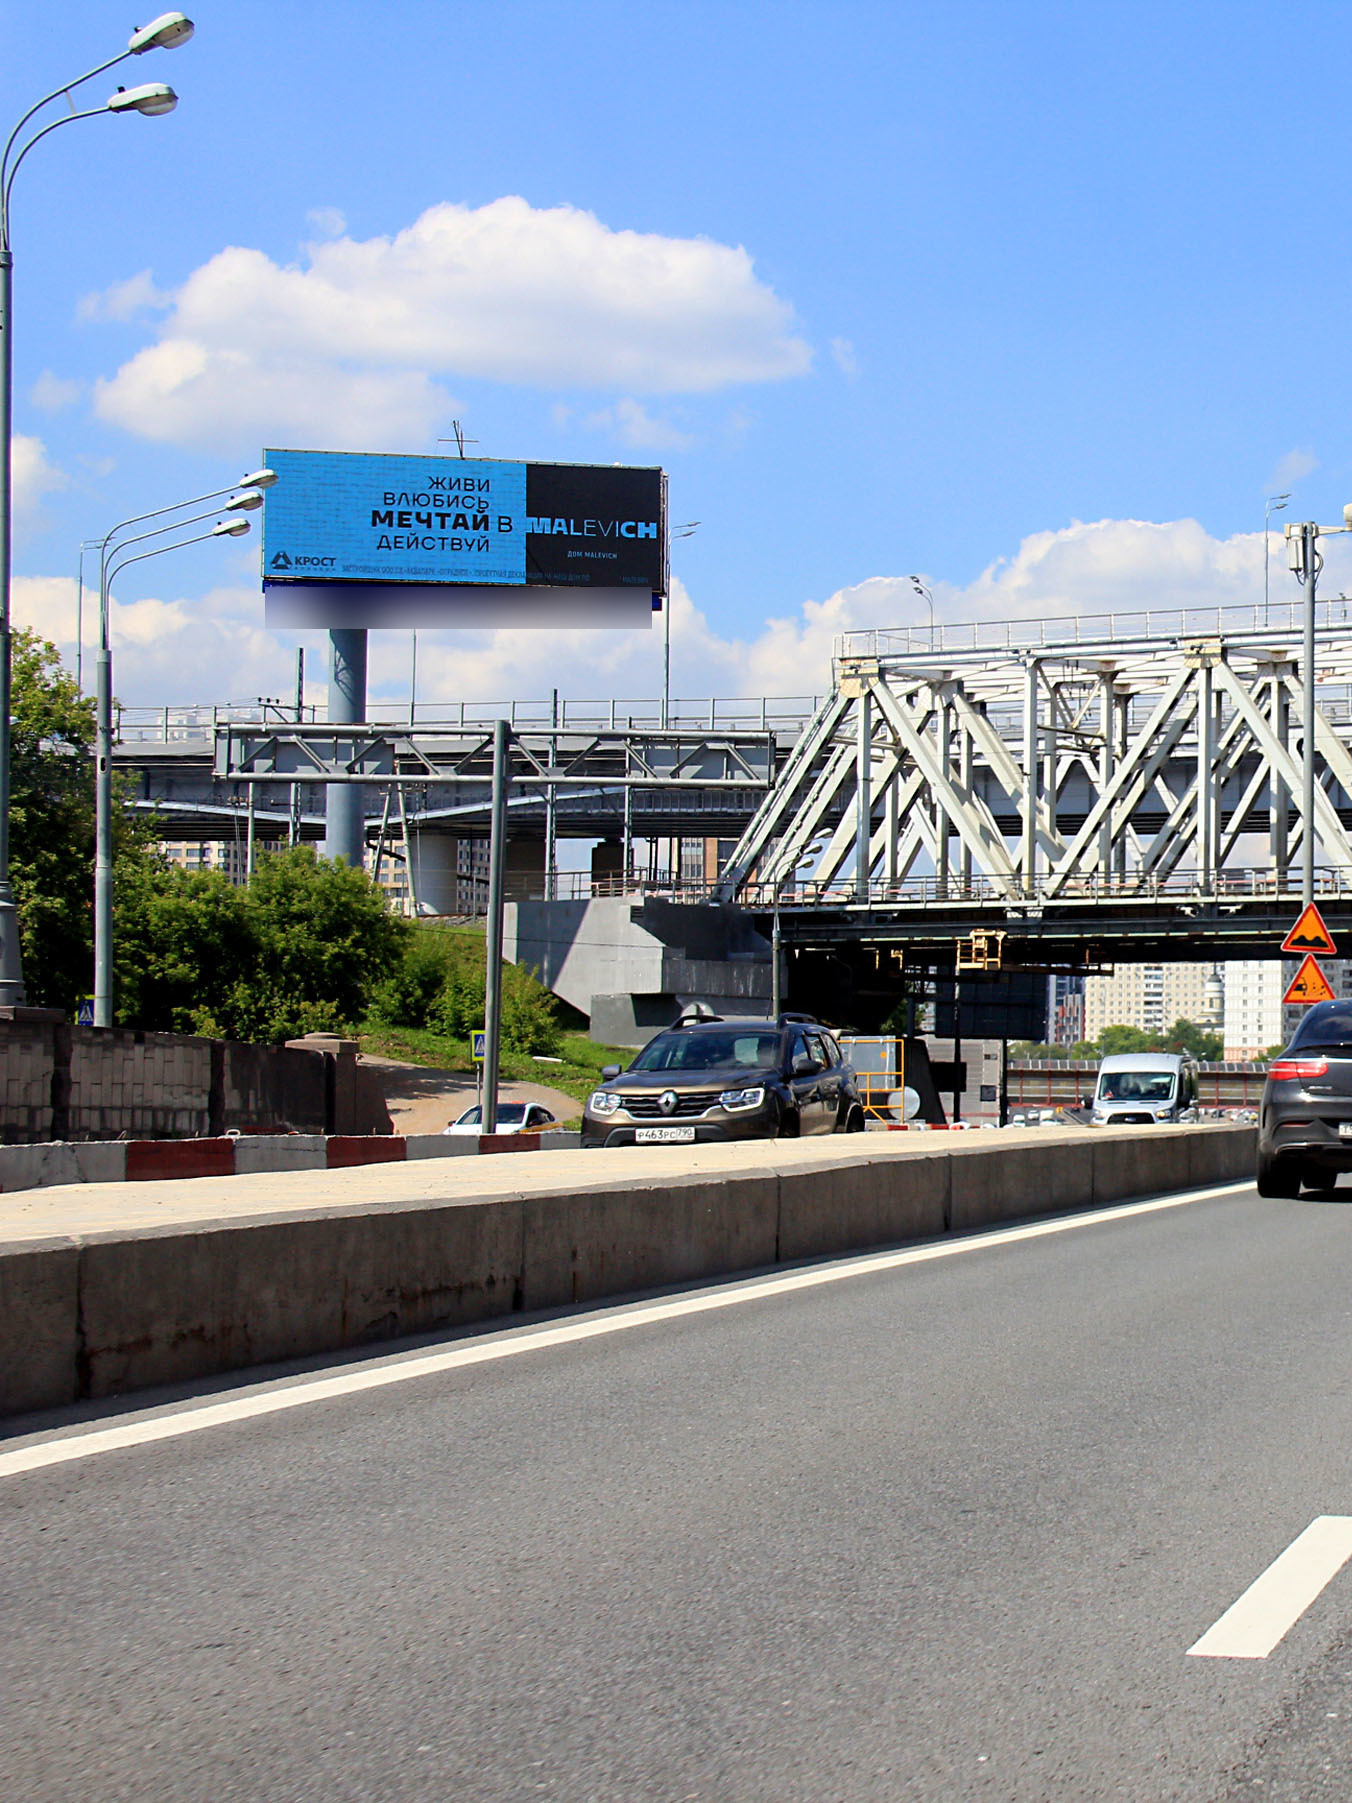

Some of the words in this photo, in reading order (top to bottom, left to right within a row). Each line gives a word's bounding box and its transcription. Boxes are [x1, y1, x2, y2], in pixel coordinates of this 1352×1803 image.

[428, 476, 490, 493] ЖИВИ
[383, 492, 490, 510] ВЛЮБИСЬ
[371, 509, 490, 532] МЕЧТАЙ
[497, 515, 513, 533] В
[525, 516, 658, 539] MALEVICH
[376, 532, 490, 553] ДЕЙСТВУЙ
[295, 556, 337, 567] КРОСТ
[567, 550, 583, 559] ДОМ
